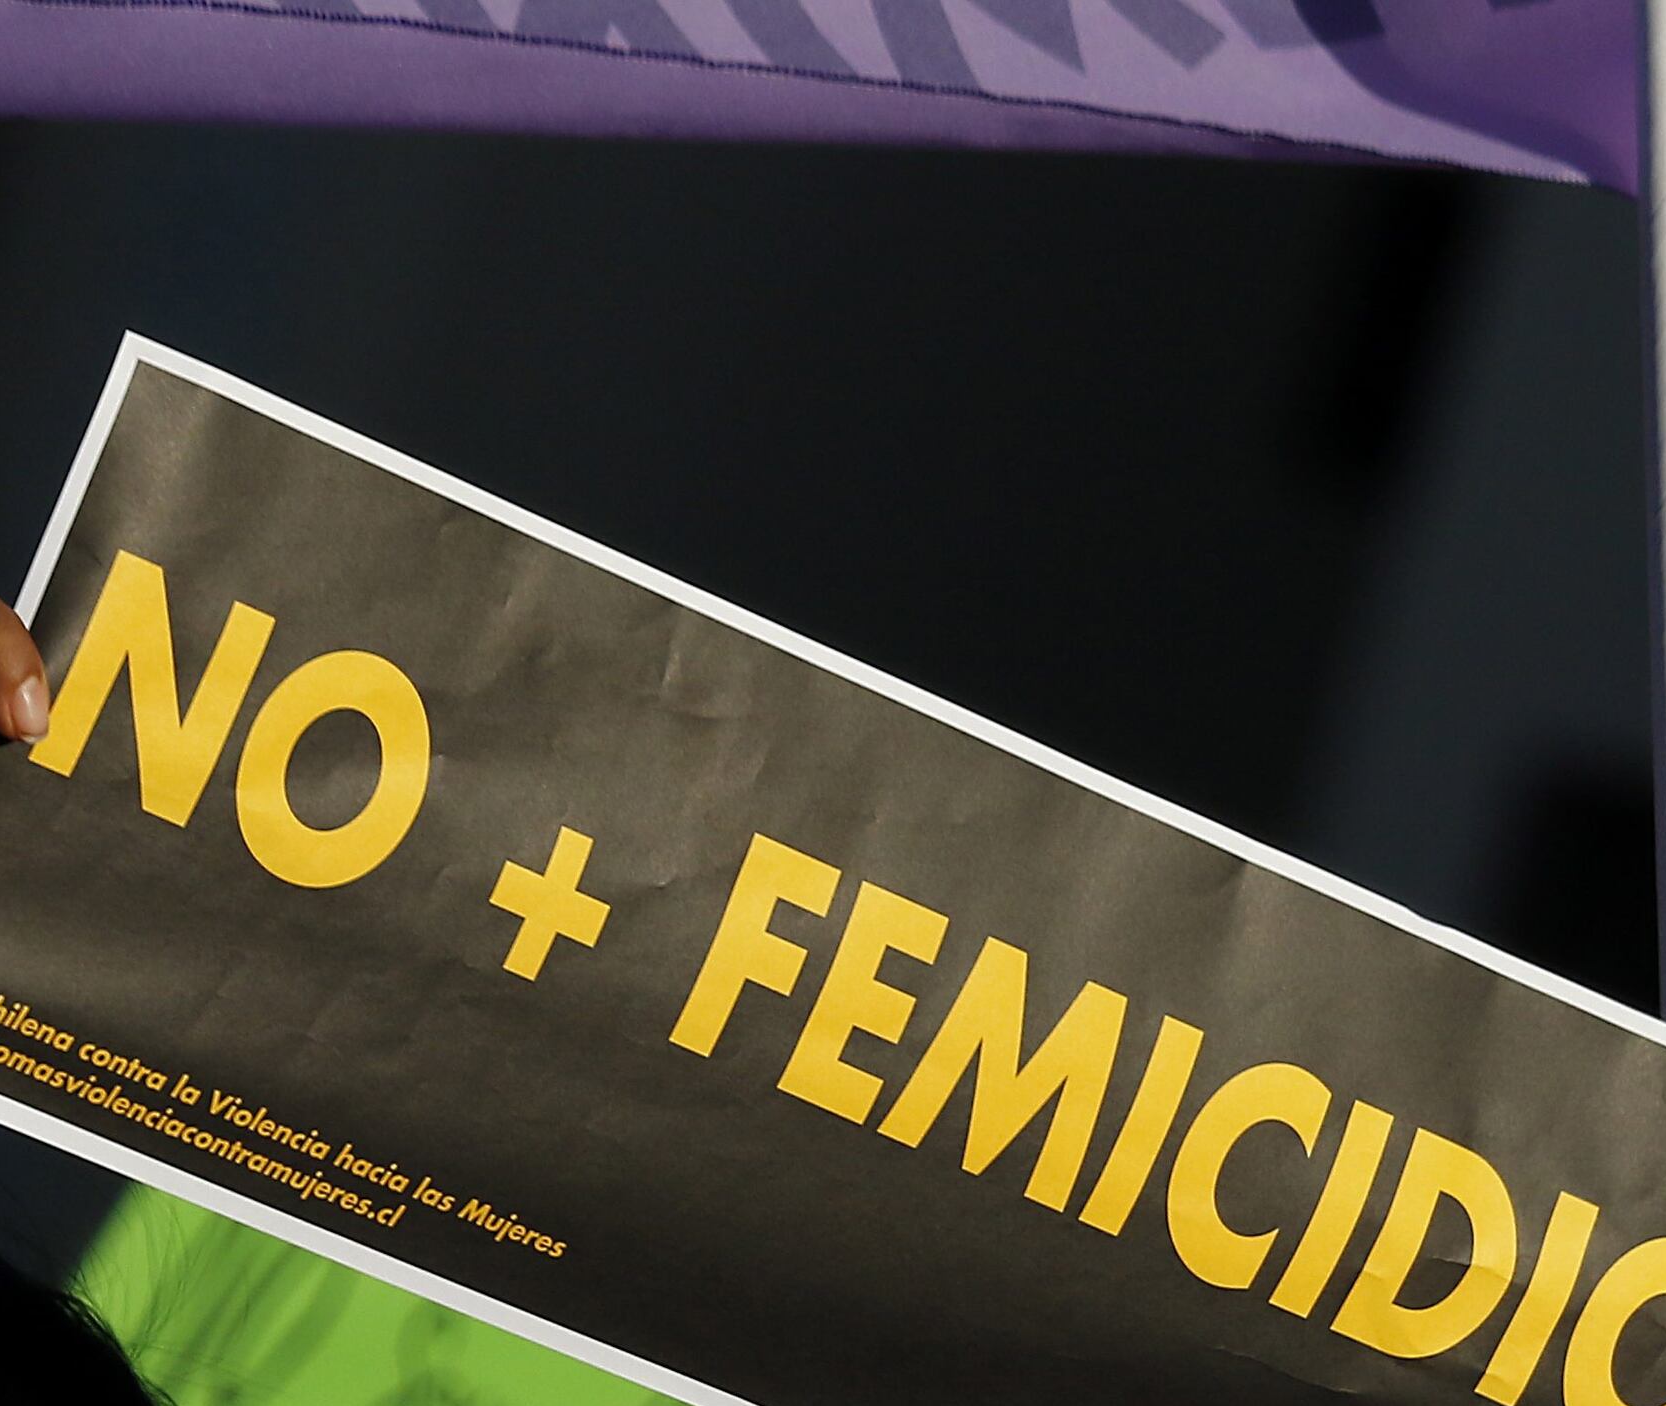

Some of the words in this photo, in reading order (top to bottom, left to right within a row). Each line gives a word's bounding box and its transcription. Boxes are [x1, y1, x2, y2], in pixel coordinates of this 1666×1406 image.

[29, 549, 430, 888] NO
[489, 826, 610, 981] +
[78, 1036, 167, 1092] contra
[170, 1073, 201, 1106] la
[208, 1089, 331, 1161] Violencia
[334, 1143, 409, 1195] hacia
[412, 1175, 454, 1213] las
[457, 1198, 566, 1260] Mujeres
